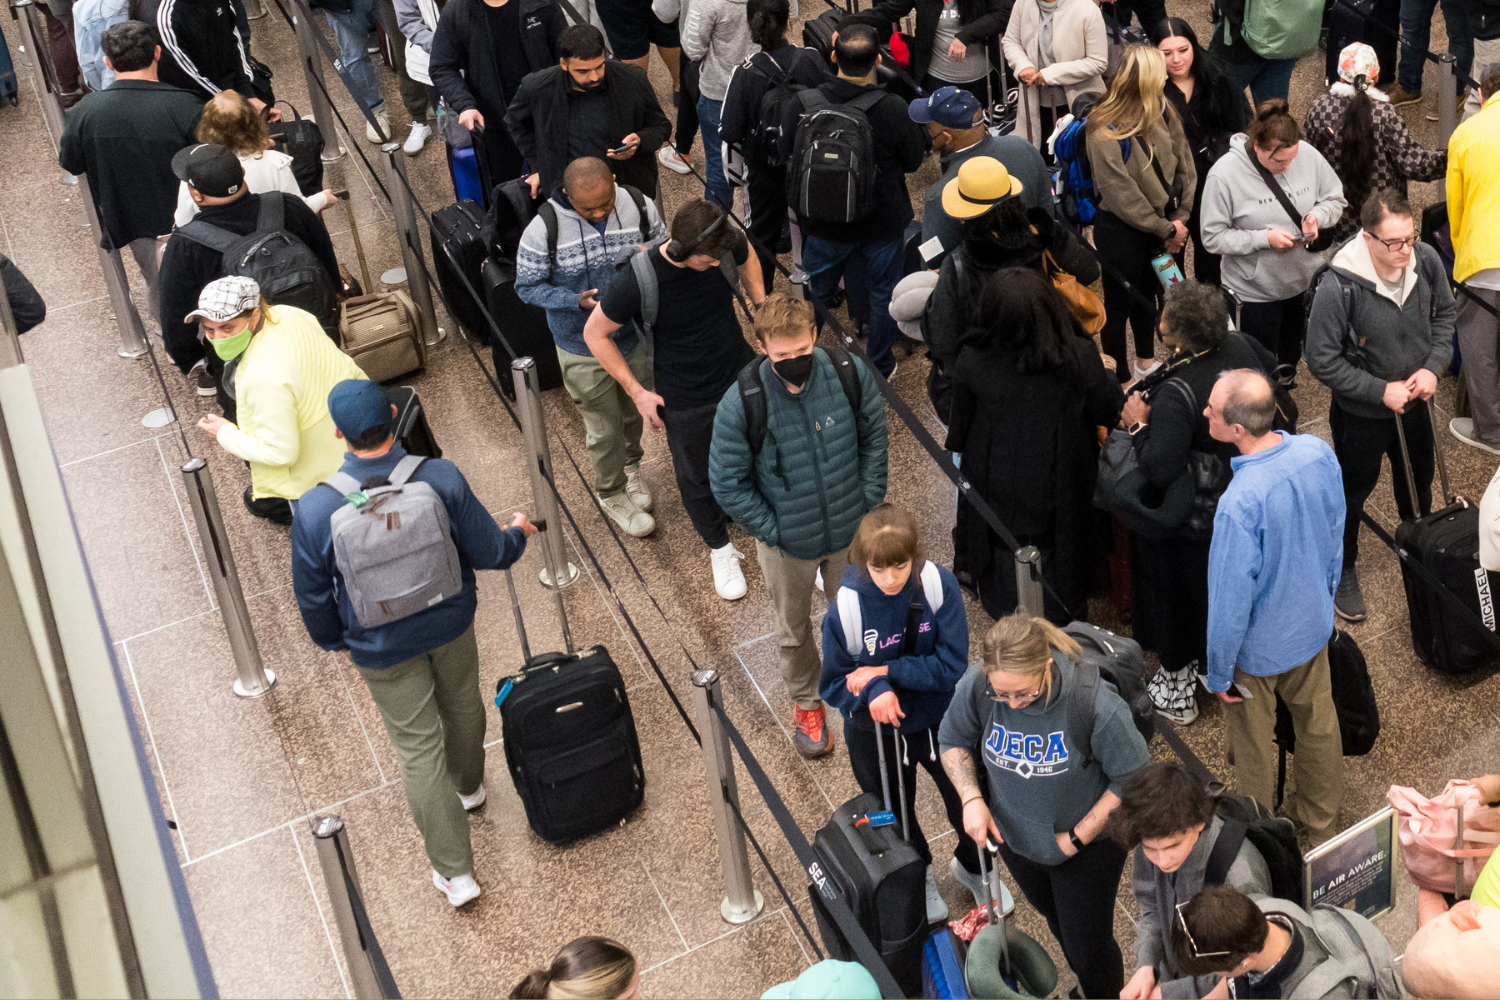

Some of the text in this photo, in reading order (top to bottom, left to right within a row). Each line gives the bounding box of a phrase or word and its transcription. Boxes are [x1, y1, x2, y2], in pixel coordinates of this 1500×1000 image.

[1296, 187, 1310, 196] CITY
[1477, 568, 1495, 630] MICHAEL
[985, 721, 1069, 764] DECA
[808, 861, 827, 891] SEA
[1312, 851, 1387, 900] BE AIR AWARE.
